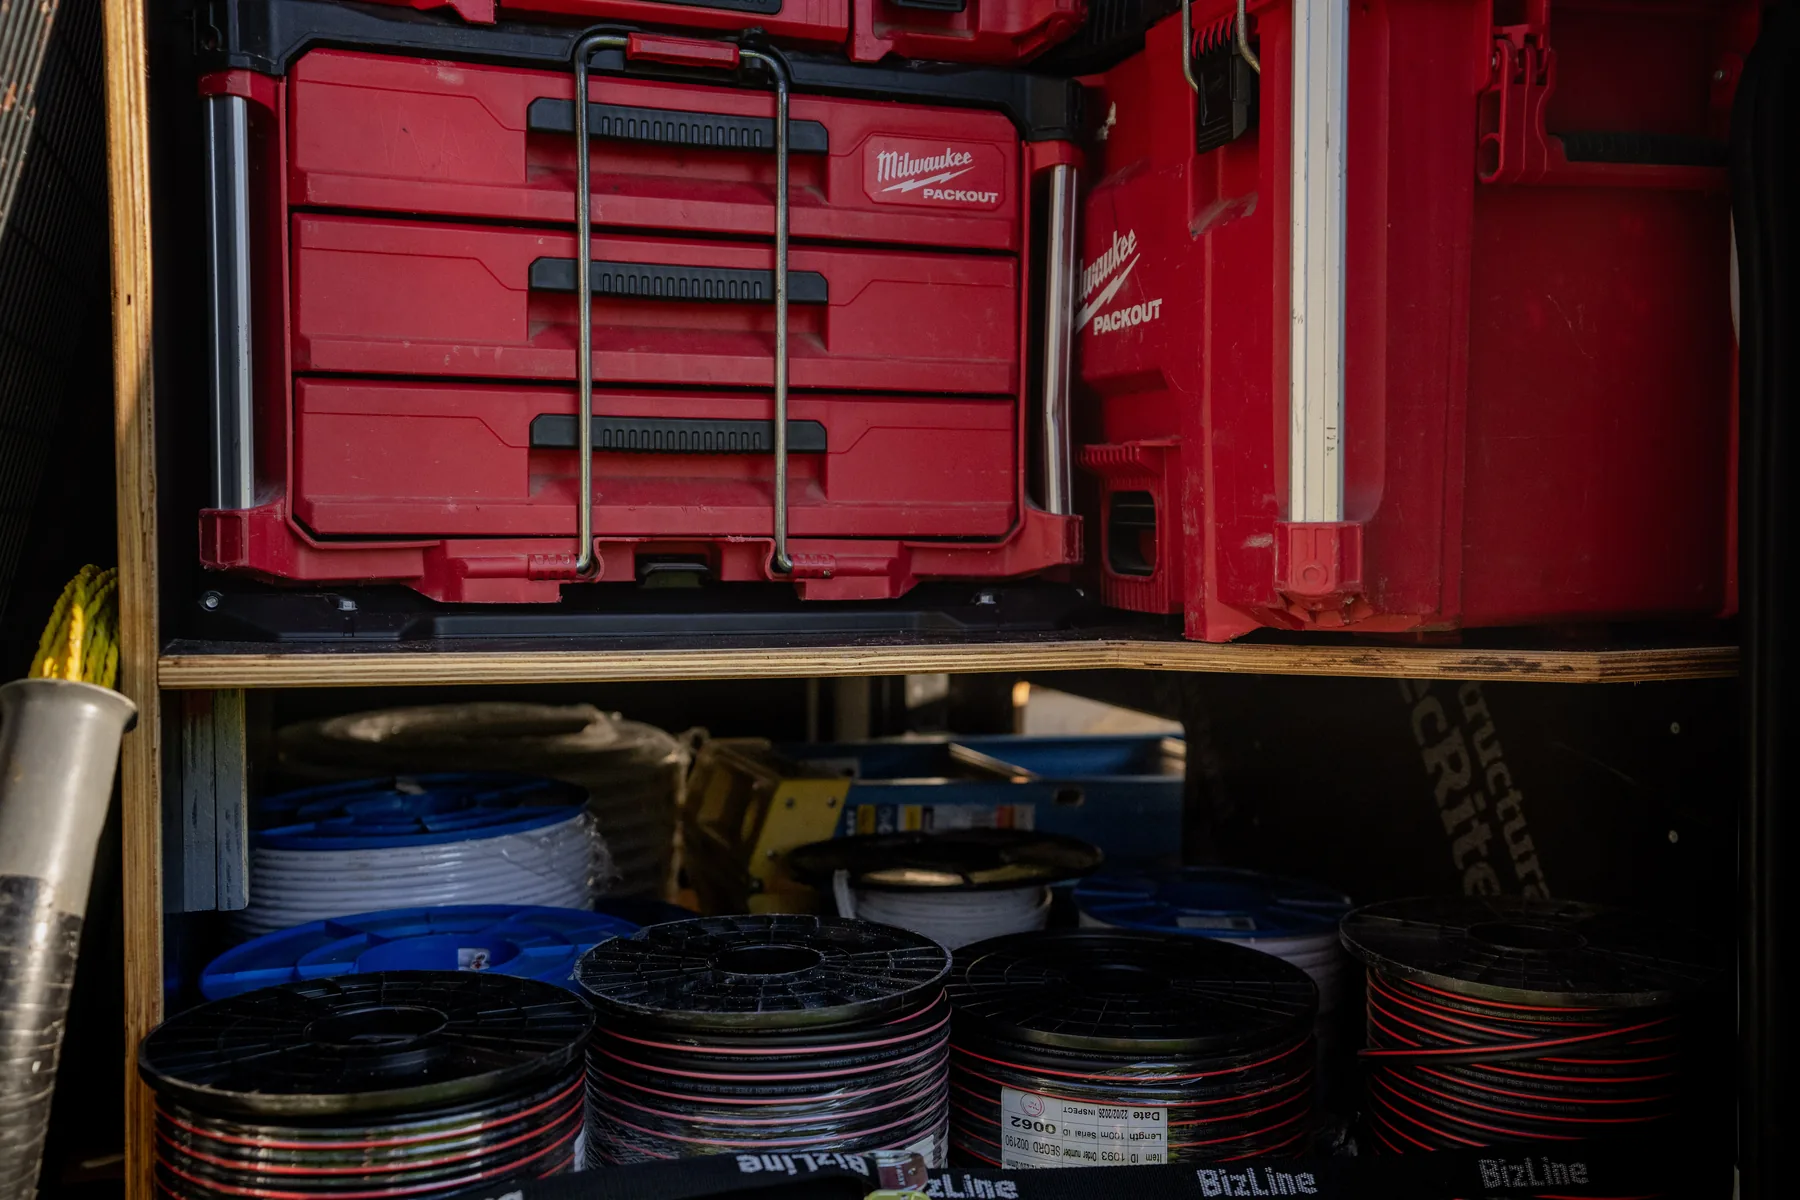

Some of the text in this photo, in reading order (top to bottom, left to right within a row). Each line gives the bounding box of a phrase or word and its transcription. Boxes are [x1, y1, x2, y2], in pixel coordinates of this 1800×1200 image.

[876, 147, 974, 182] Milwaukee
[923, 188, 999, 204] PACKOUT
[1093, 298, 1163, 336] PACKOUT
[1062, 1106, 1096, 1116] INSPECT
[1132, 1110, 1160, 1122] Date
[1010, 1115, 1162, 1142] Length 100m Serial ID 0062
[1004, 1134, 1163, 1163] Item ID 1093 Order number SEORD 002190
[736, 1151, 871, 1178] BizLine
[1477, 1156, 1590, 1190] BizLine
[1197, 1166, 1319, 1199] BizLine
